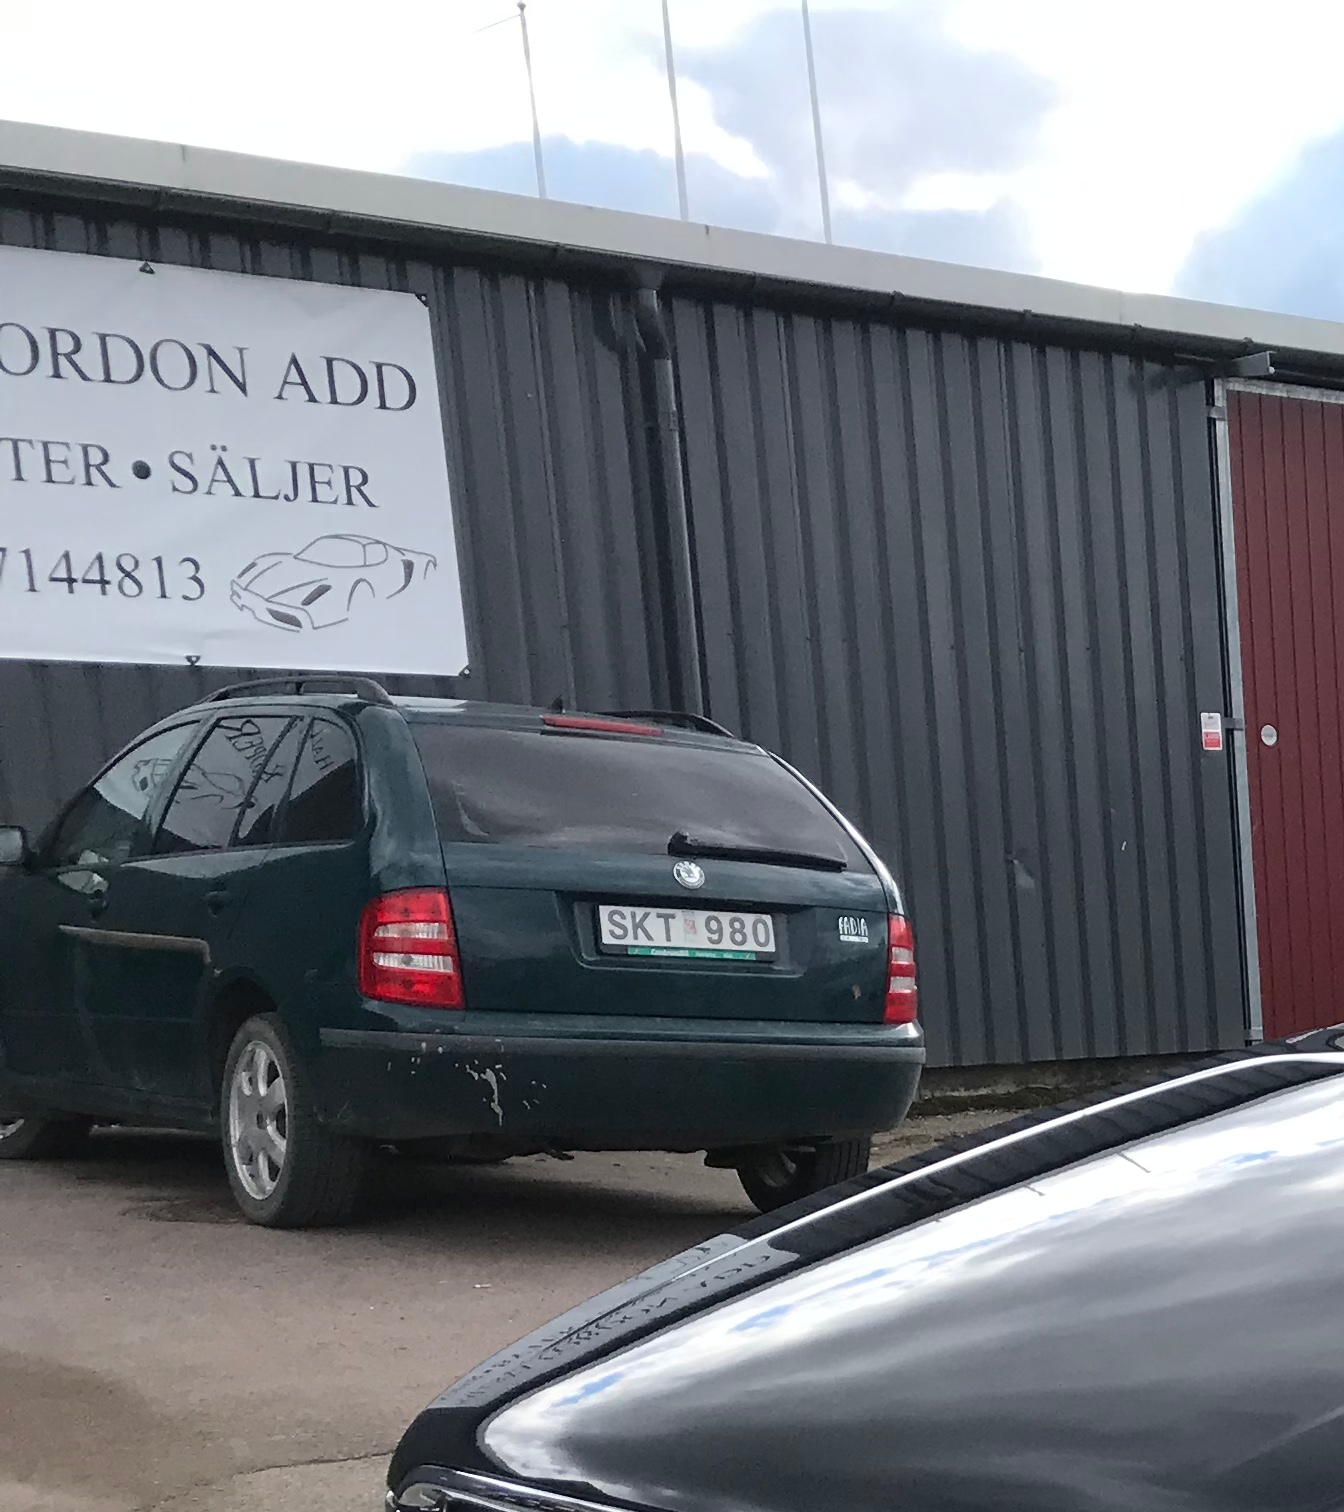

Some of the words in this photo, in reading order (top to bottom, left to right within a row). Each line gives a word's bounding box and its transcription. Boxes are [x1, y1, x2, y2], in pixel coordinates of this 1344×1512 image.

[273, 352, 417, 412] ADD
[168, 443, 380, 508] SÄLJER
[607, 909, 677, 942] SKT
[704, 914, 771, 948] 980
